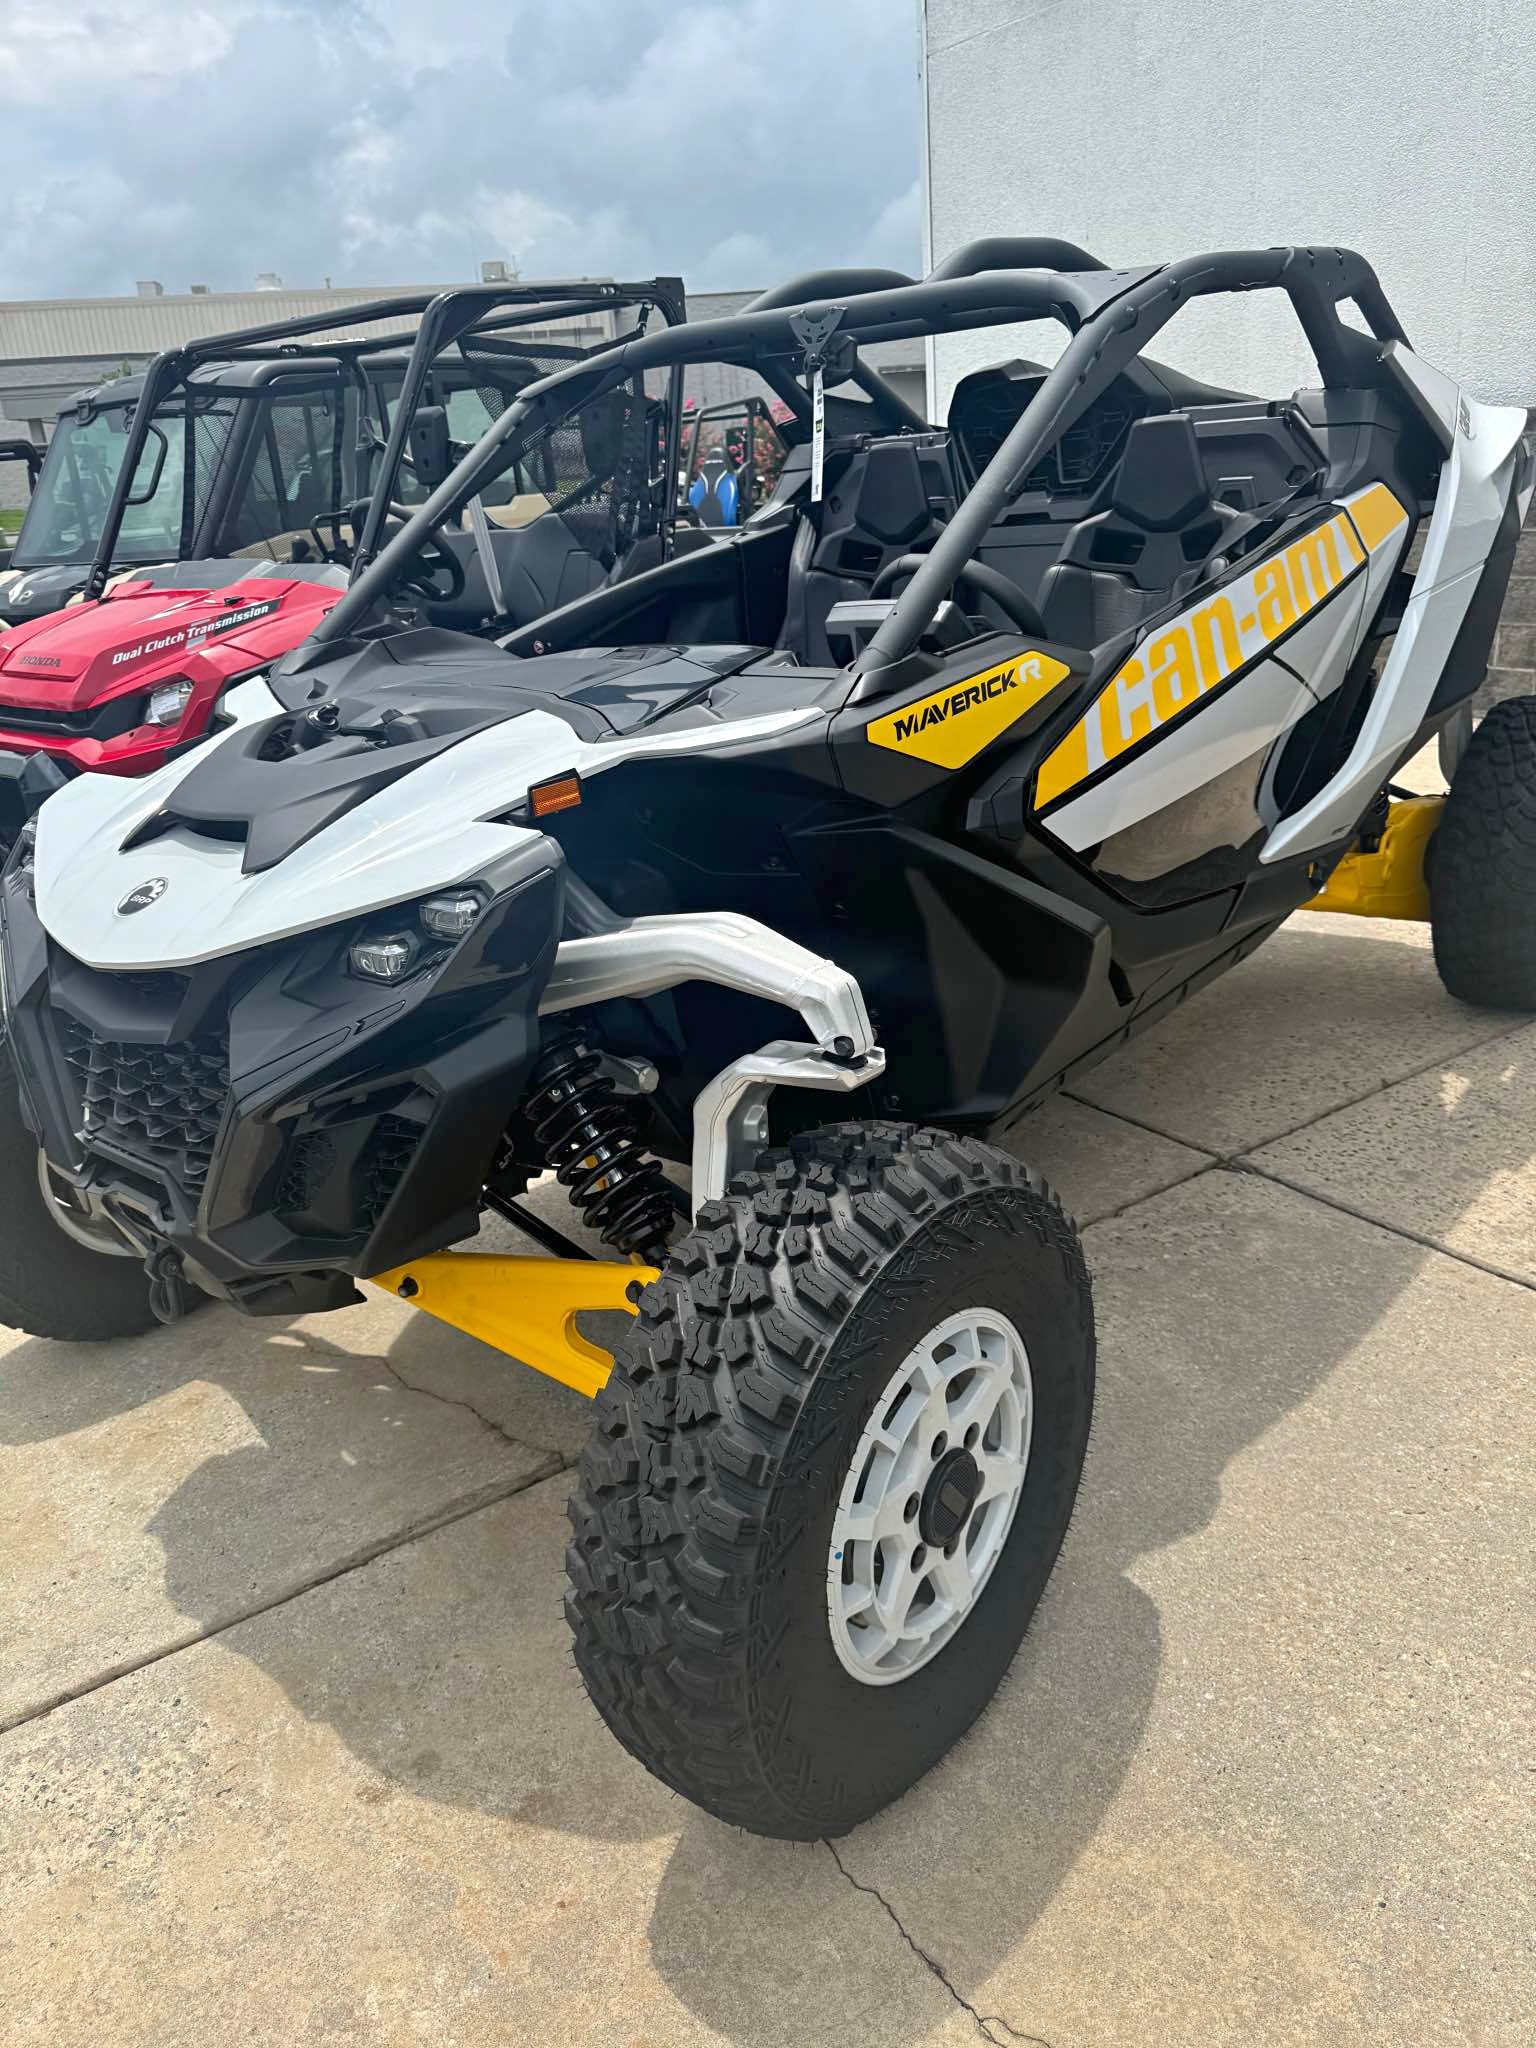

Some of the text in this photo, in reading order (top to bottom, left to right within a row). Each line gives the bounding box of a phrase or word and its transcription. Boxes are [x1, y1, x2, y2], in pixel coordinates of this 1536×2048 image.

[19, 656, 61, 668] HONDA
[112, 604, 269, 666] Dual Clutch Transmission
[893, 657, 1042, 742] MAVERICK R
